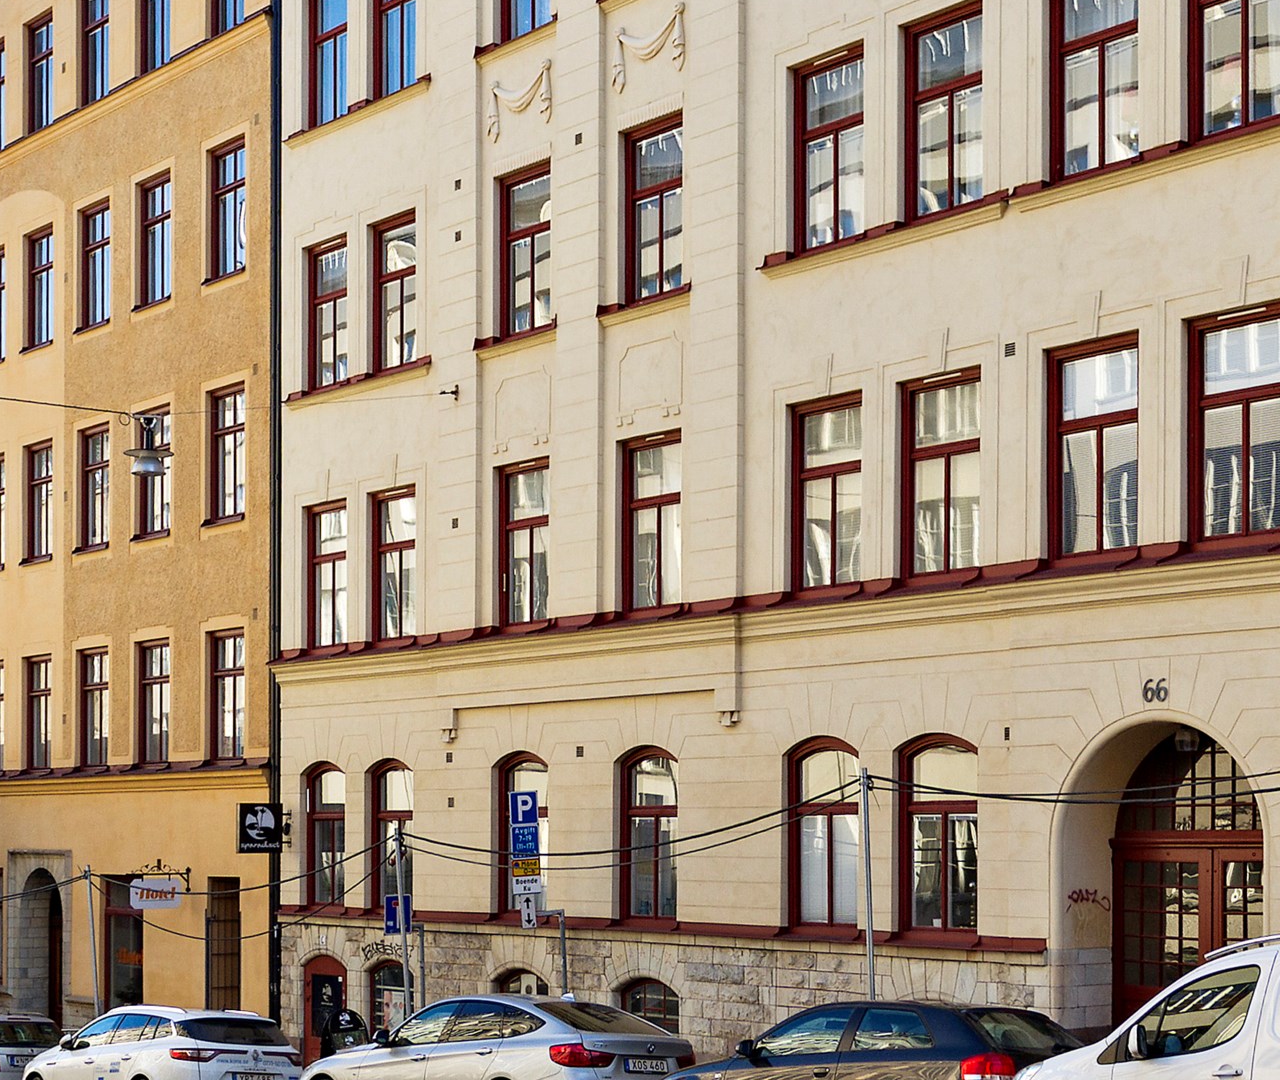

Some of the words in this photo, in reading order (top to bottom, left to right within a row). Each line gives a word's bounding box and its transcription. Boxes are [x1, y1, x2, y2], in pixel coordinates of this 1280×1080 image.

[1143, 678, 1168, 702] 66
[517, 795, 533, 822] P
[515, 827, 536, 835] Avgift
[632, 1061, 648, 1070] XOS
[649, 1061, 665, 1071] 460
